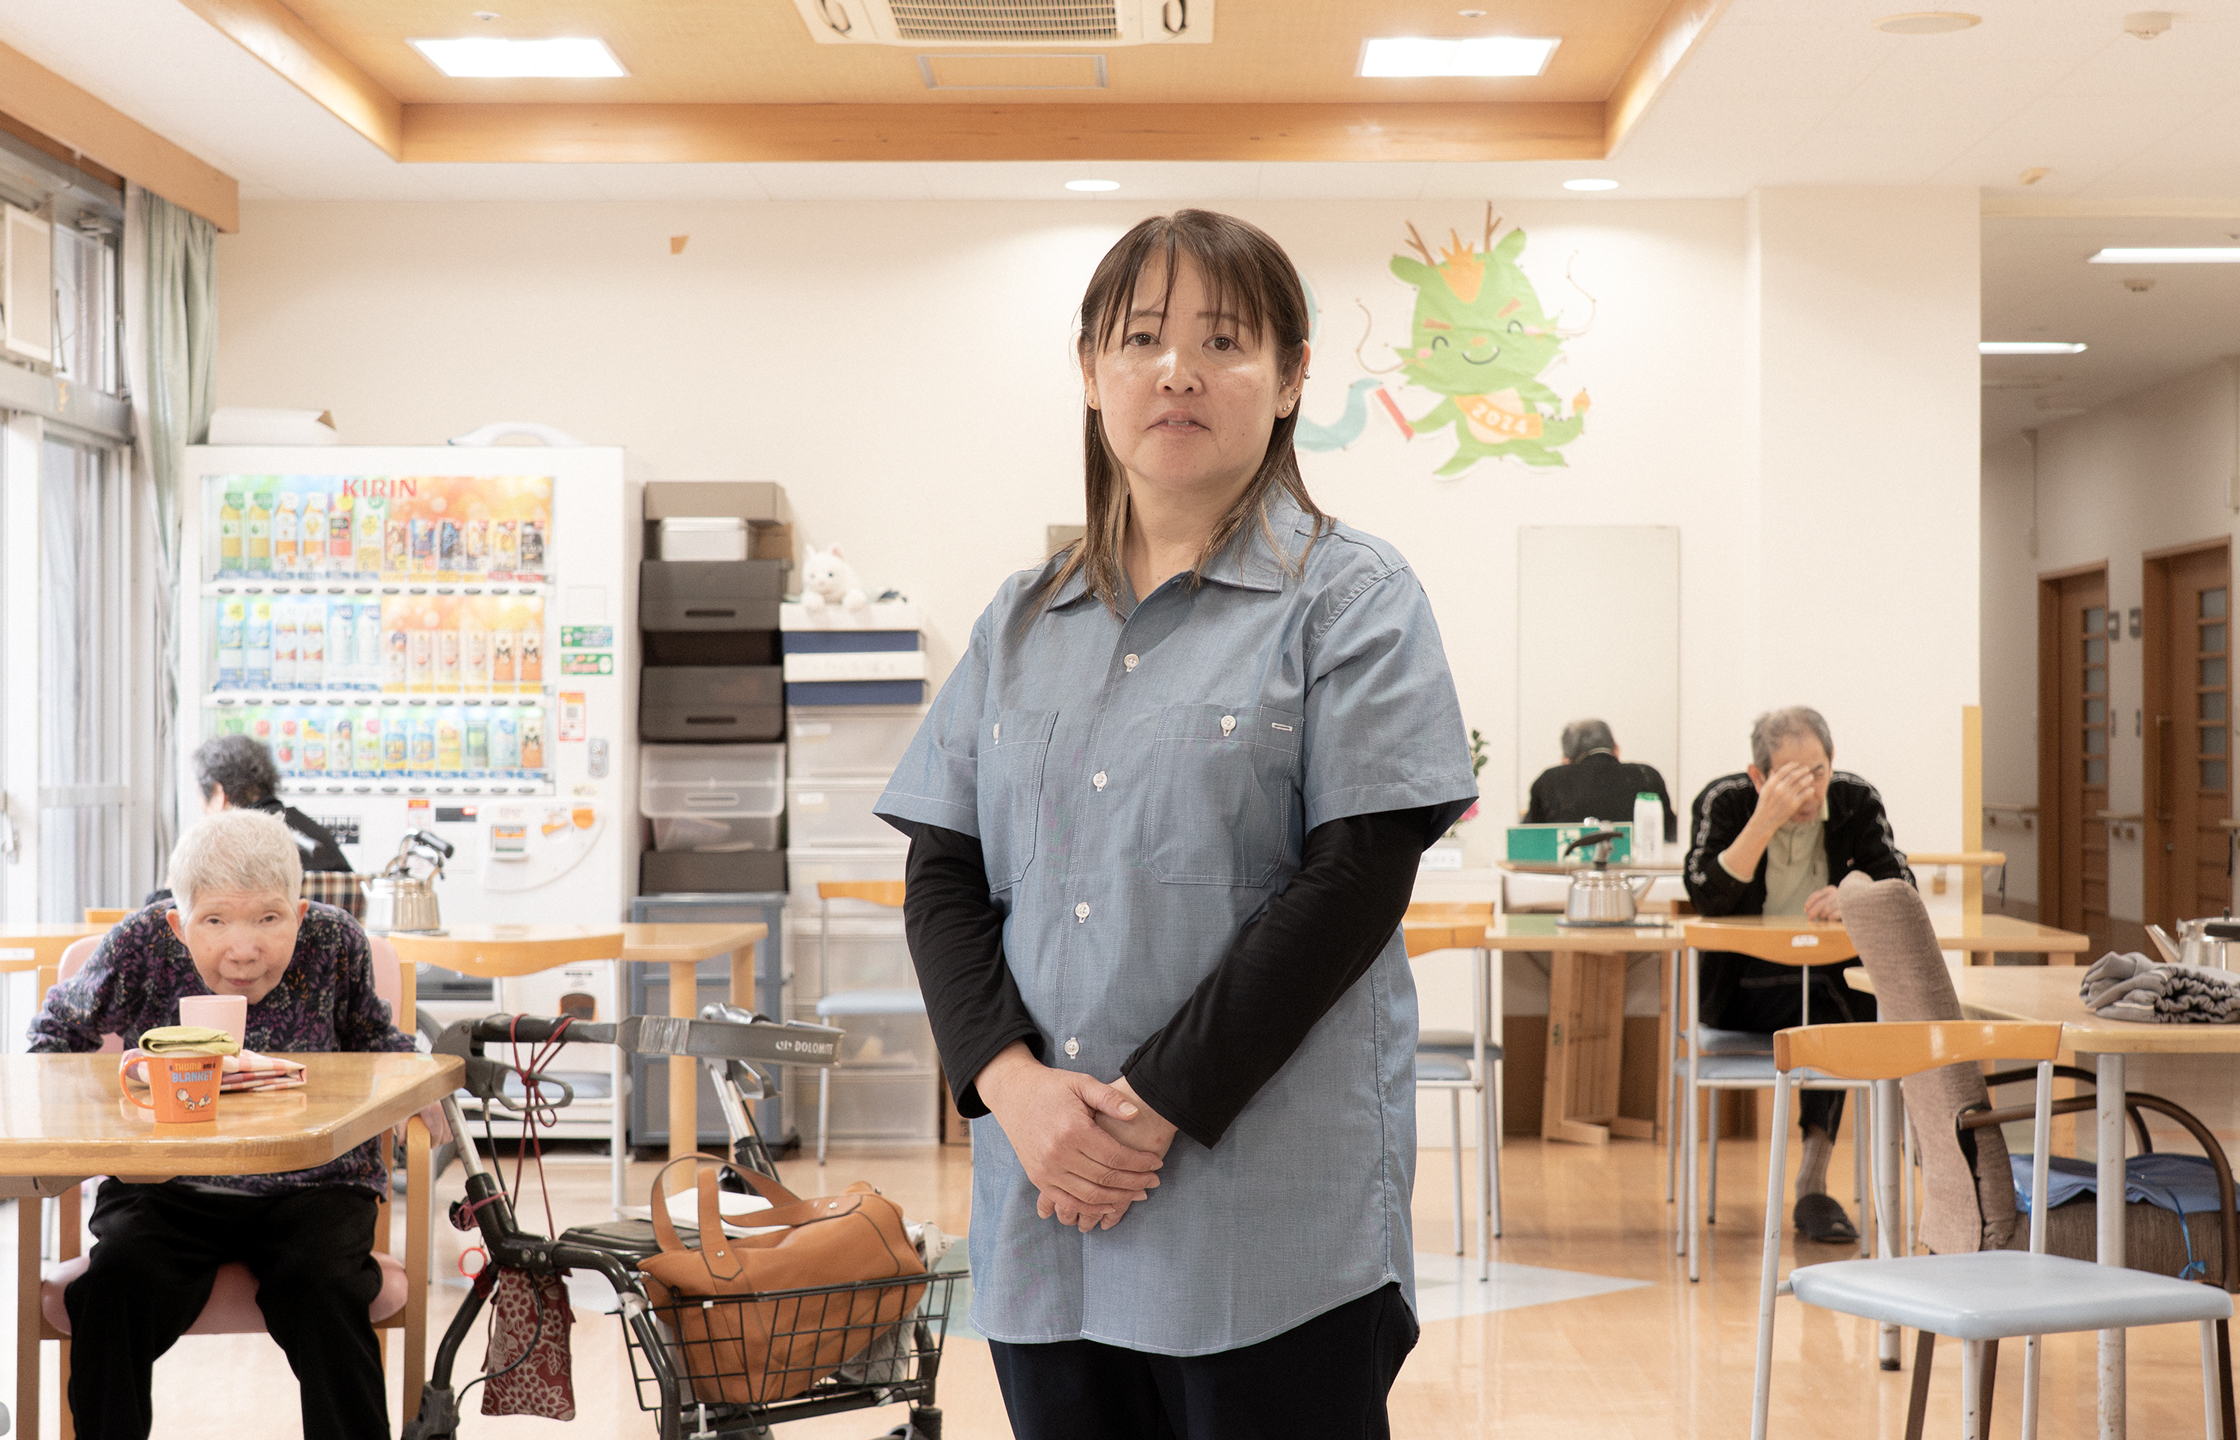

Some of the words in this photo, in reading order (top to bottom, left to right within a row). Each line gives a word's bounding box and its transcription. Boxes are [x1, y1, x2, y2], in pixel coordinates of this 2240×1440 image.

[1472, 402, 1527, 434] 2024
[343, 479, 417, 498] KIRIN
[794, 1040, 833, 1055] DOLOMITE
[172, 1070, 213, 1083] BLANKET
